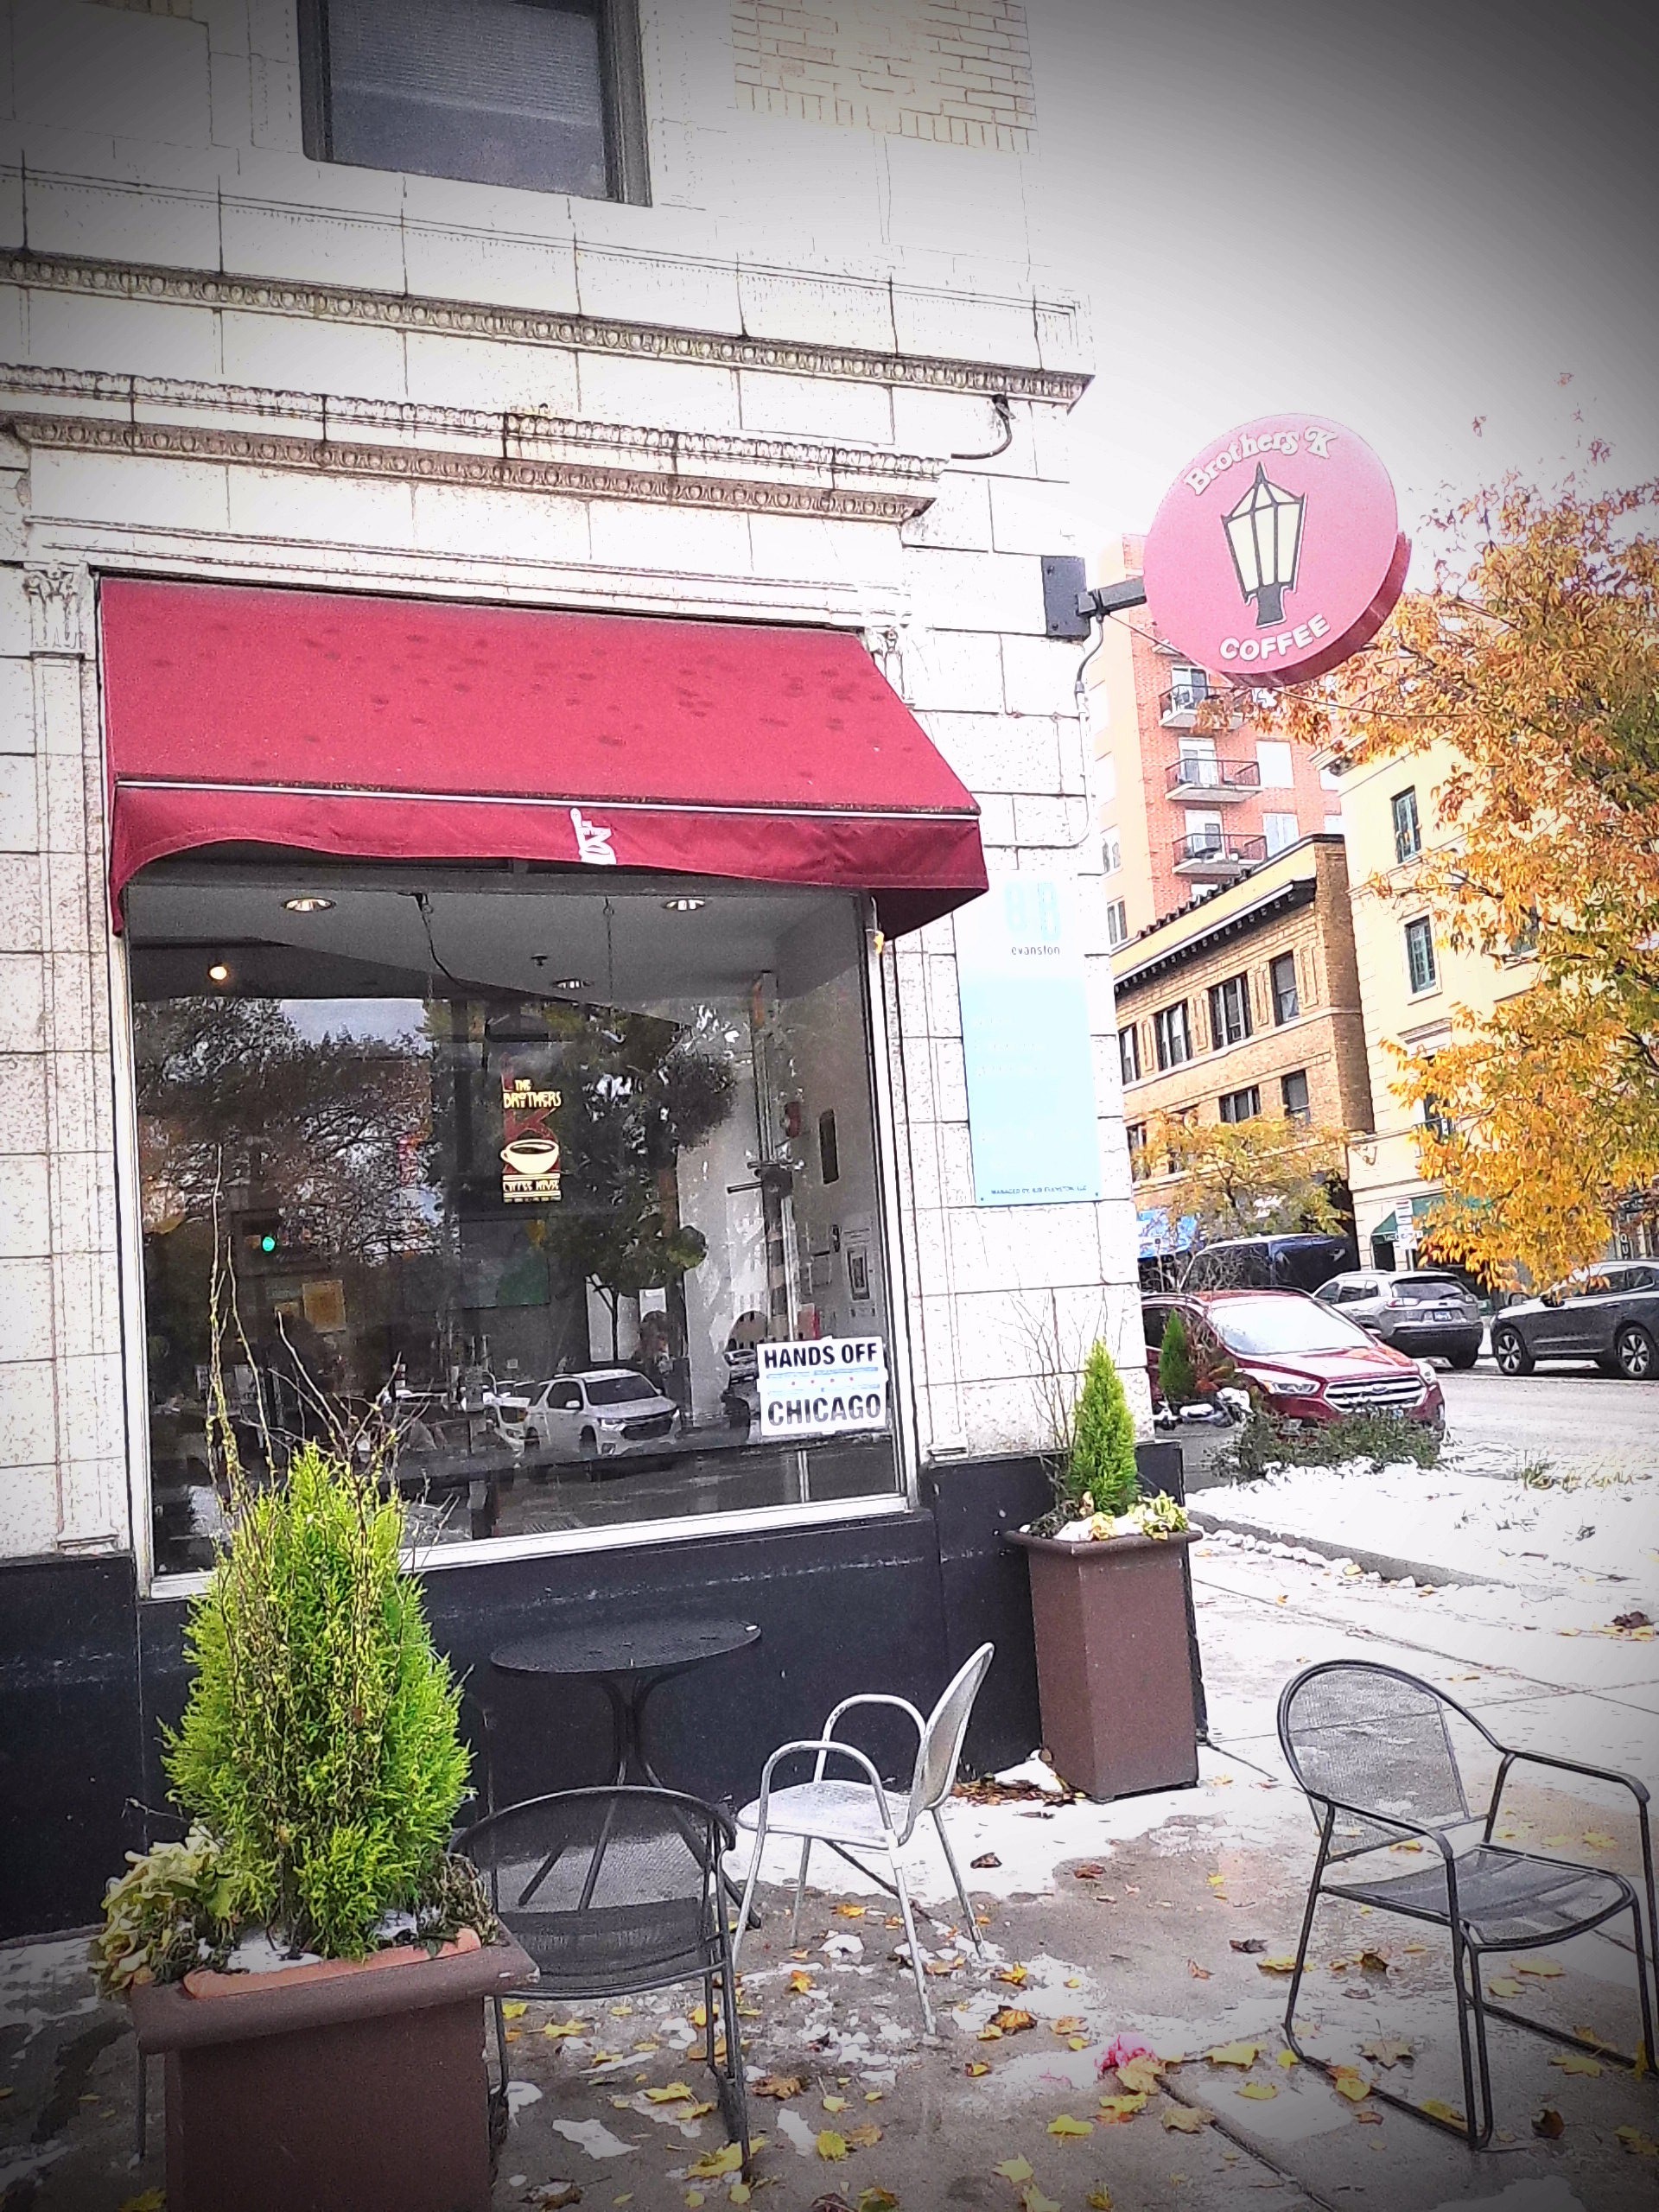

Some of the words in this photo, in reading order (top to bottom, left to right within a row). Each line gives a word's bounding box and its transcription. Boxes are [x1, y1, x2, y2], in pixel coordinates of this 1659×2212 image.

[1185, 429, 1300, 496] Brothers
[1303, 425, 1339, 459] K
[1219, 613, 1331, 661] COFFEE
[503, 1091, 562, 1109] BROTHERS
[764, 1344, 836, 1370] HANDS
[841, 1343, 877, 1364] OFF
[767, 1393, 881, 1427] CHICAGO
